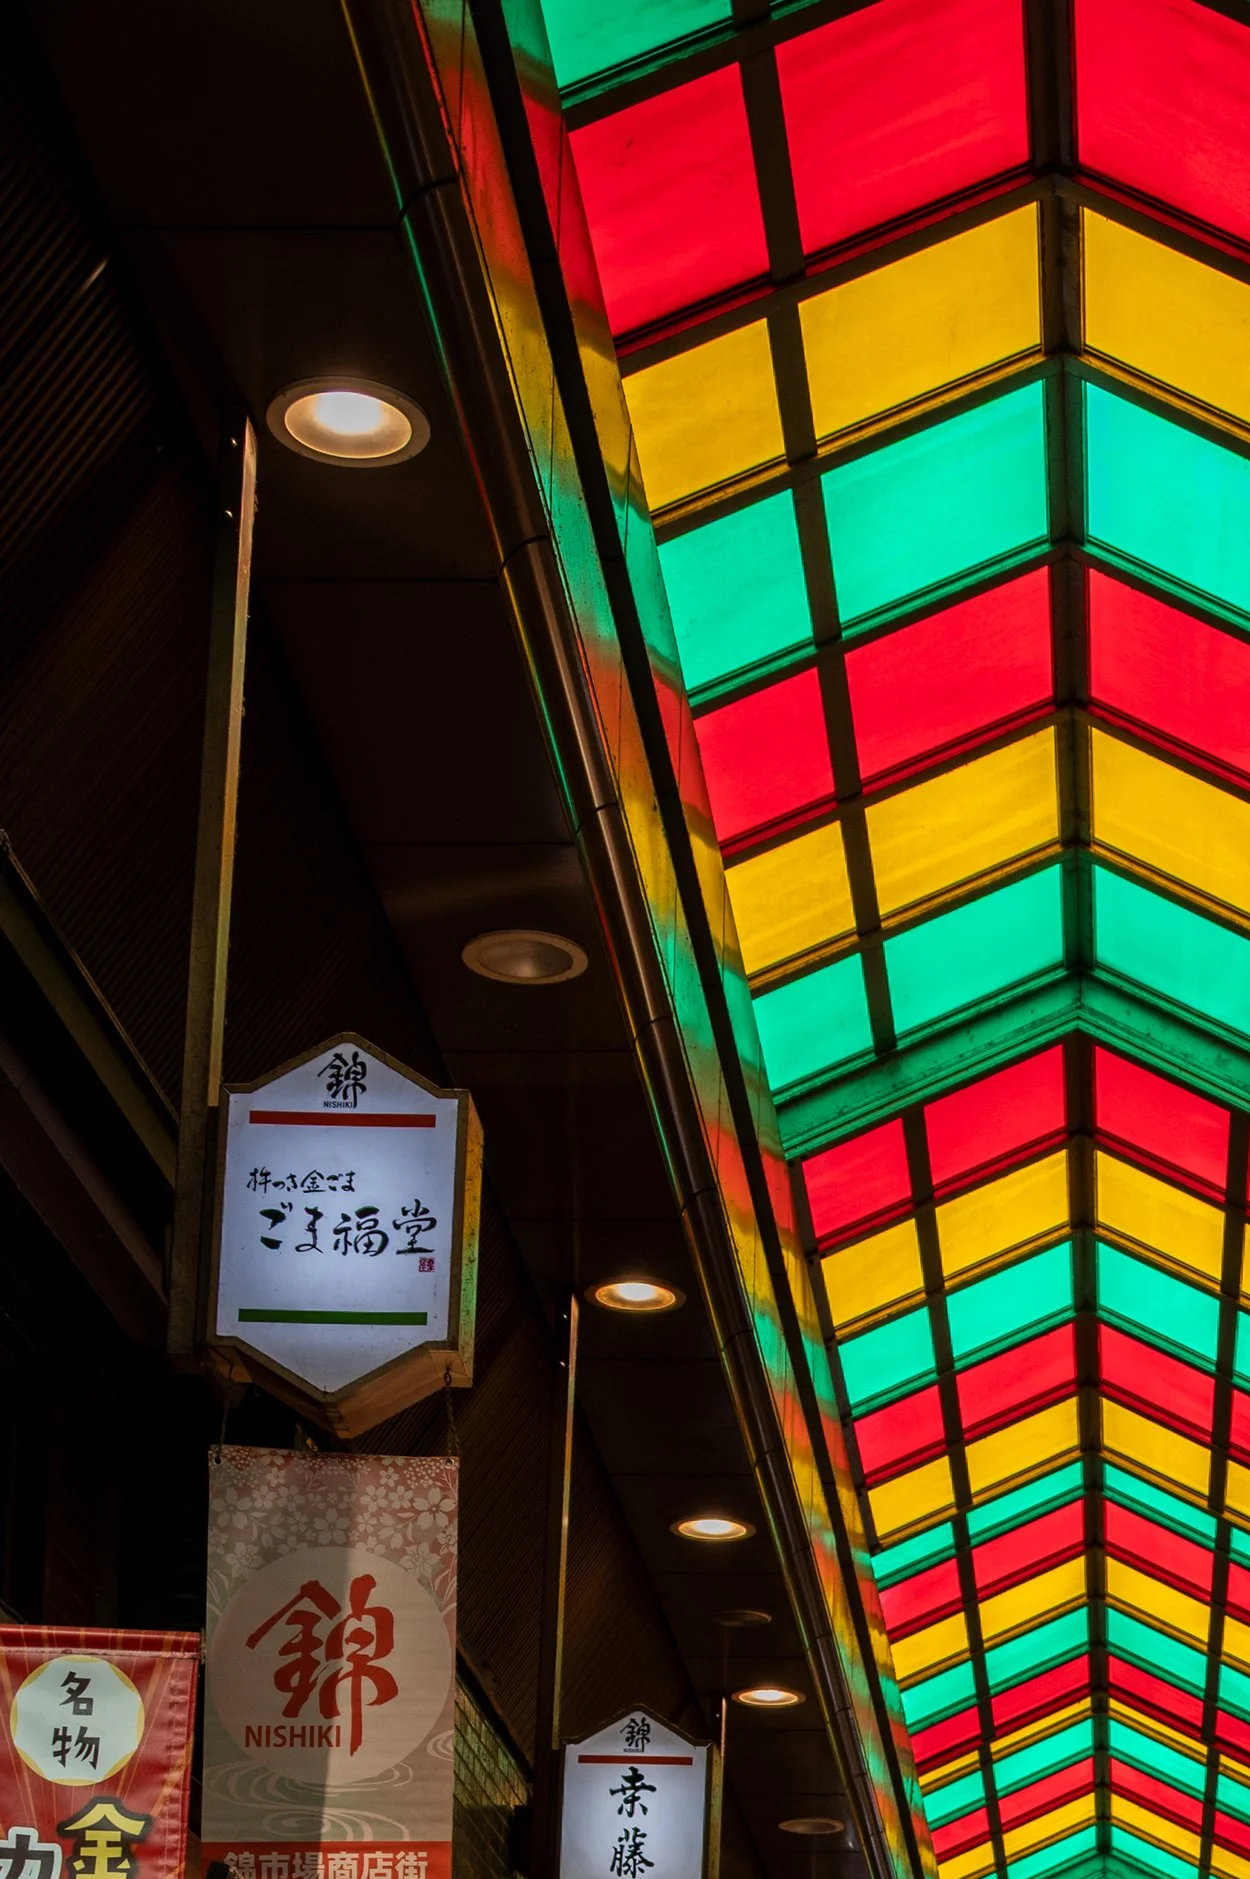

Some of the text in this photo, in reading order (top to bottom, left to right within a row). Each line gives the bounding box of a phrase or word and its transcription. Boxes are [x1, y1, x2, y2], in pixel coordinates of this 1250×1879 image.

[317, 1050, 368, 1109] 錦
[322, 1100, 354, 1109] NISHIKI
[258, 1198, 437, 1257] ごま福堂
[244, 1572, 400, 1758] 錦
[51, 1670, 101, 1771] 名物
[244, 1724, 341, 1749] NISHIKI
[619, 1716, 651, 1753] 錦
